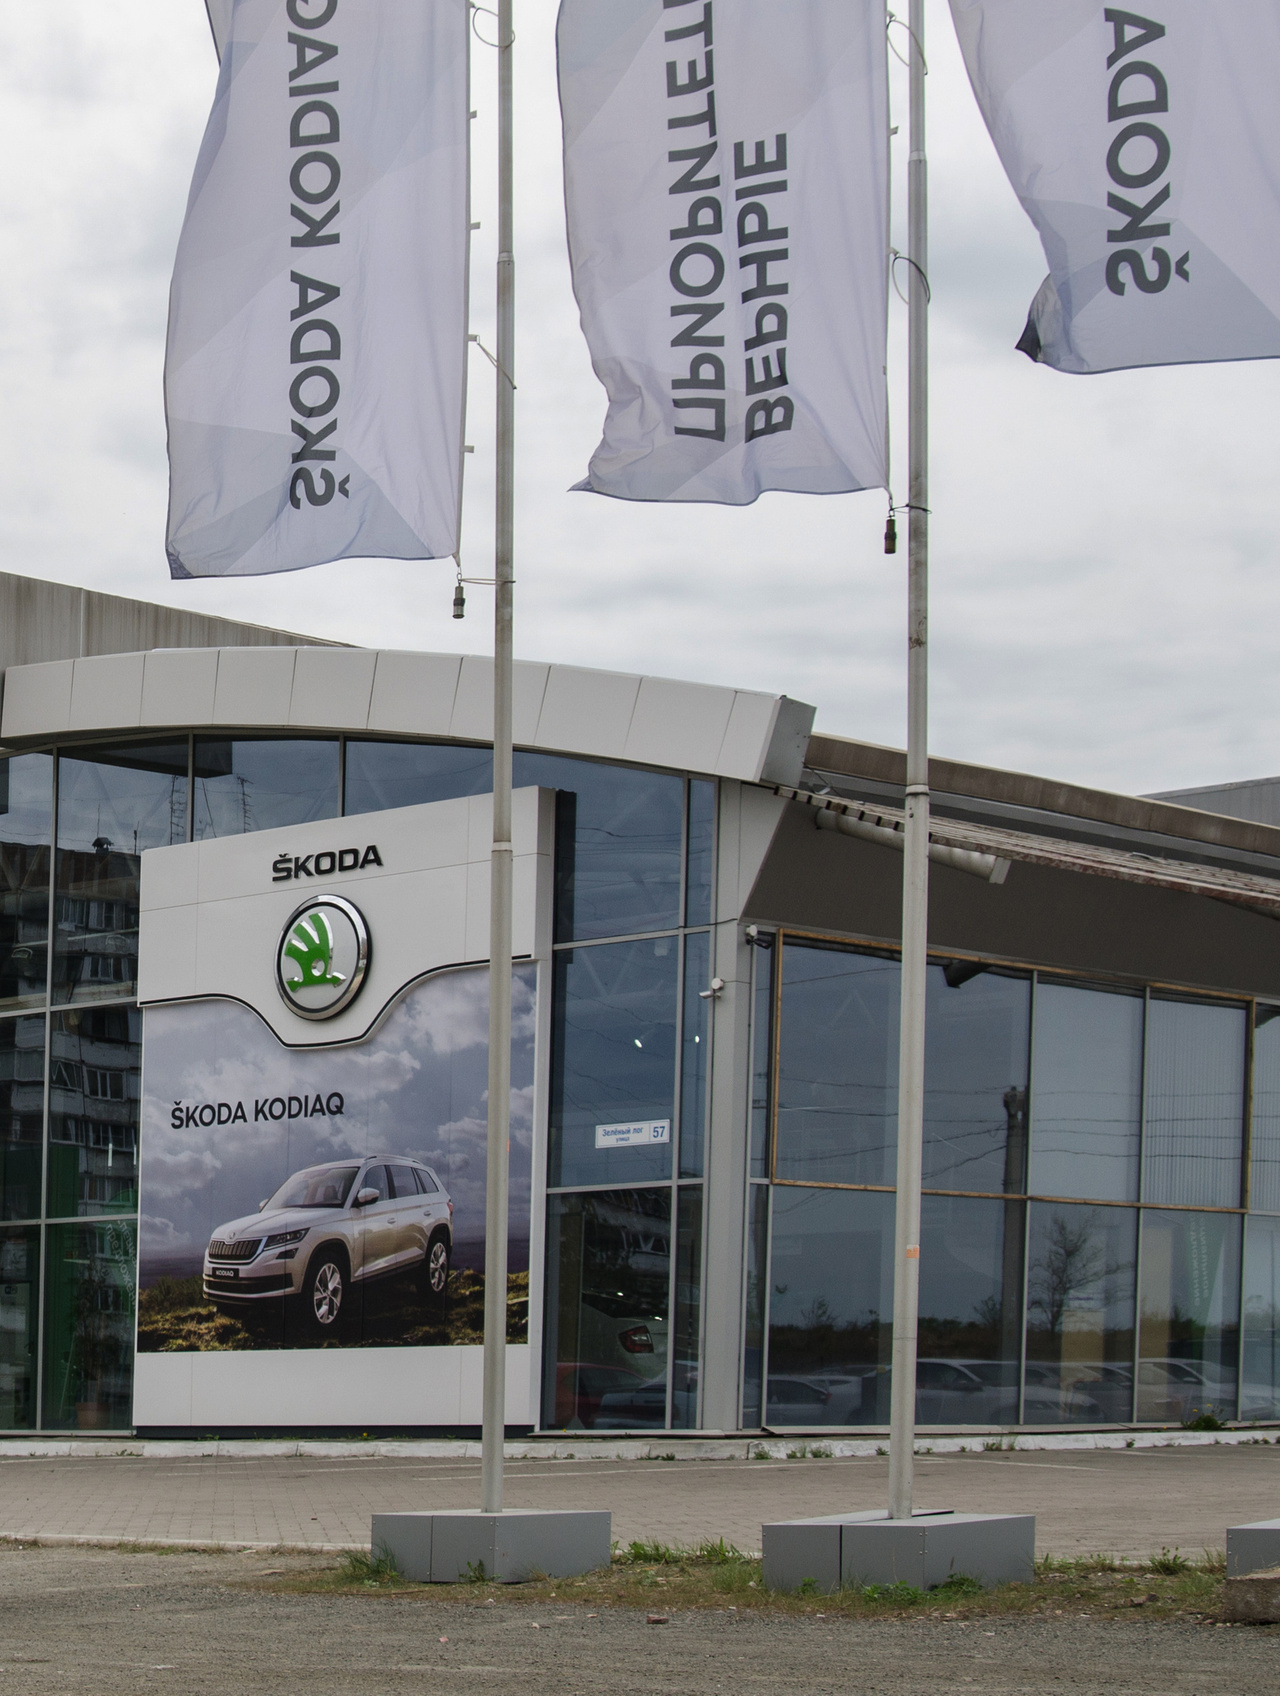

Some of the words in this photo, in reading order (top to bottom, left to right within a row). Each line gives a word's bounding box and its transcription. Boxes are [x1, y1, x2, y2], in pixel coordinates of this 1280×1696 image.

[272, 844, 384, 882] ŠKODA
[170, 1100, 248, 1130] ŠKODA
[254, 1091, 345, 1122] KODIAQ
[653, 1126, 666, 1138] 57
